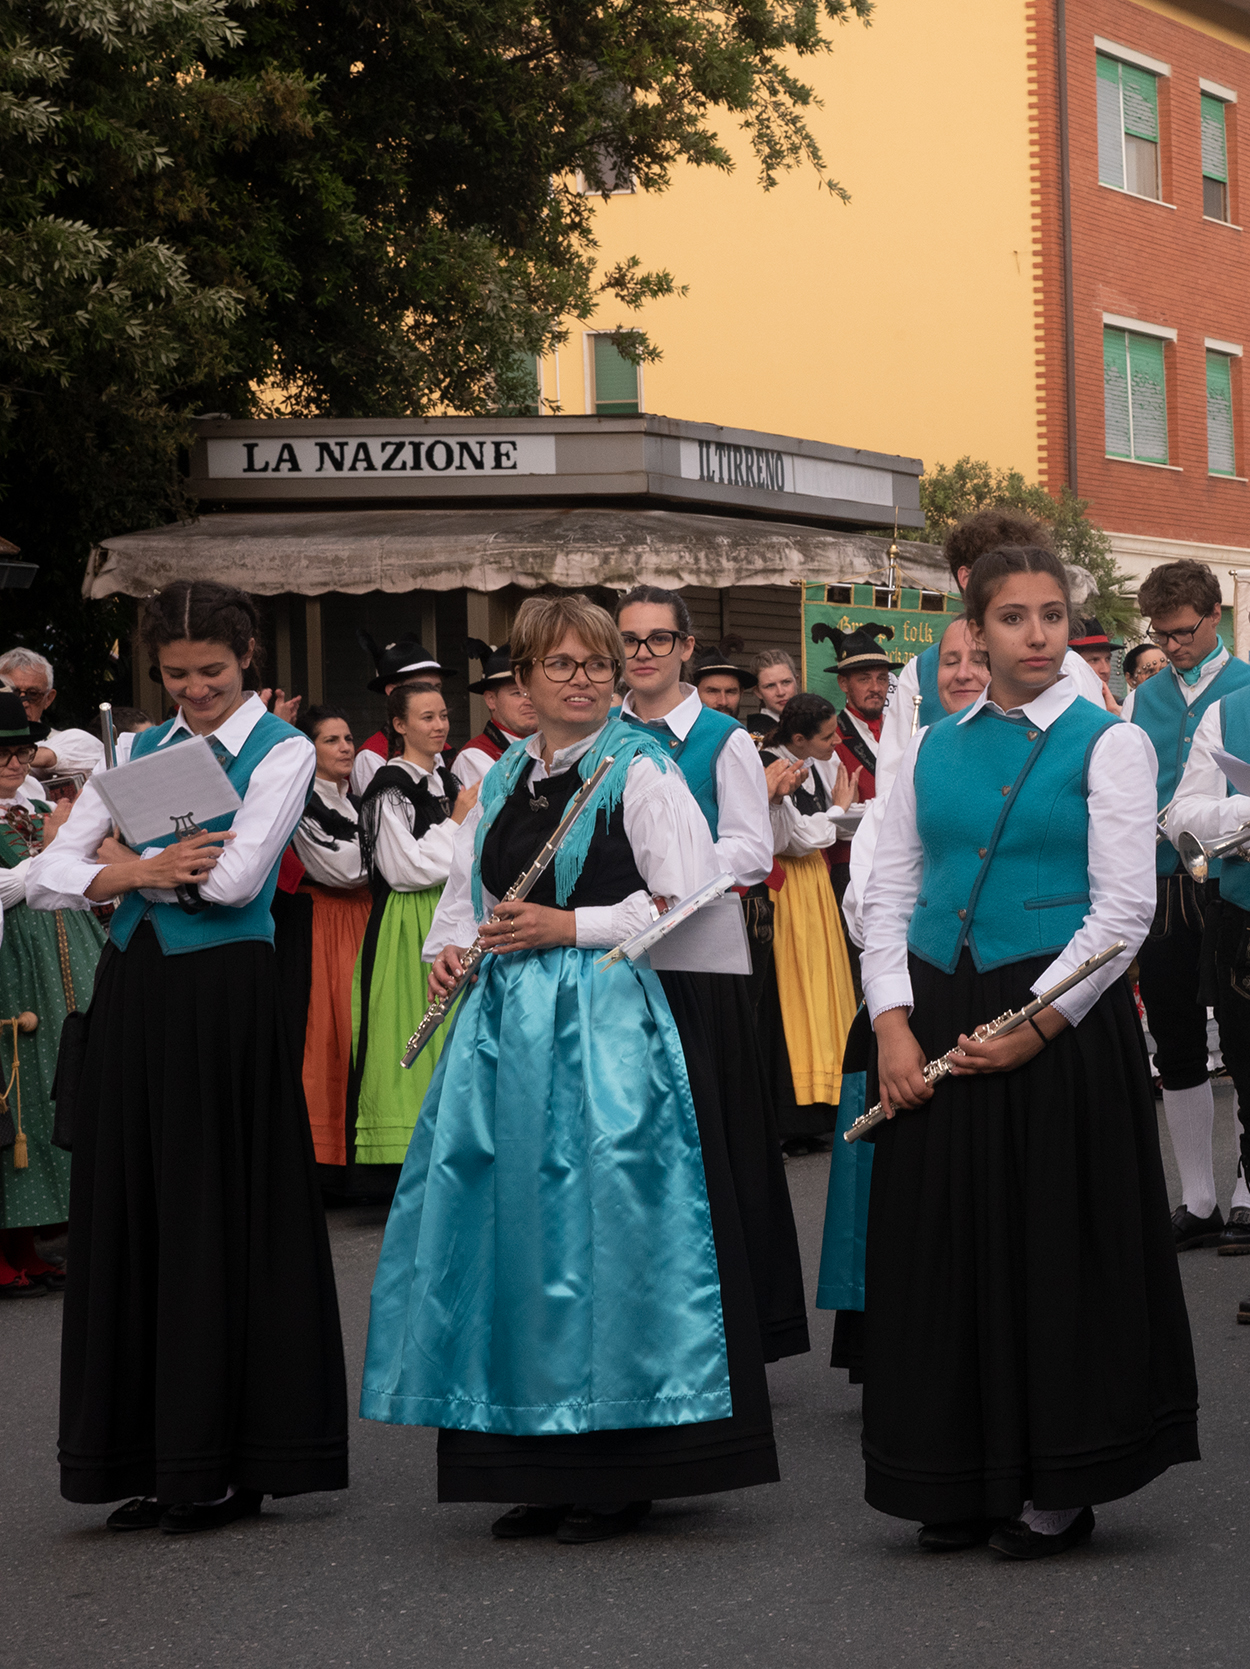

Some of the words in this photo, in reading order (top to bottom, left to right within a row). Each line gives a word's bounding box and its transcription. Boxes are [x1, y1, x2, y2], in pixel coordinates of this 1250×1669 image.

[242, 443, 302, 473] LA
[314, 440, 518, 472] NAZIONE
[903, 620, 934, 643] folk
